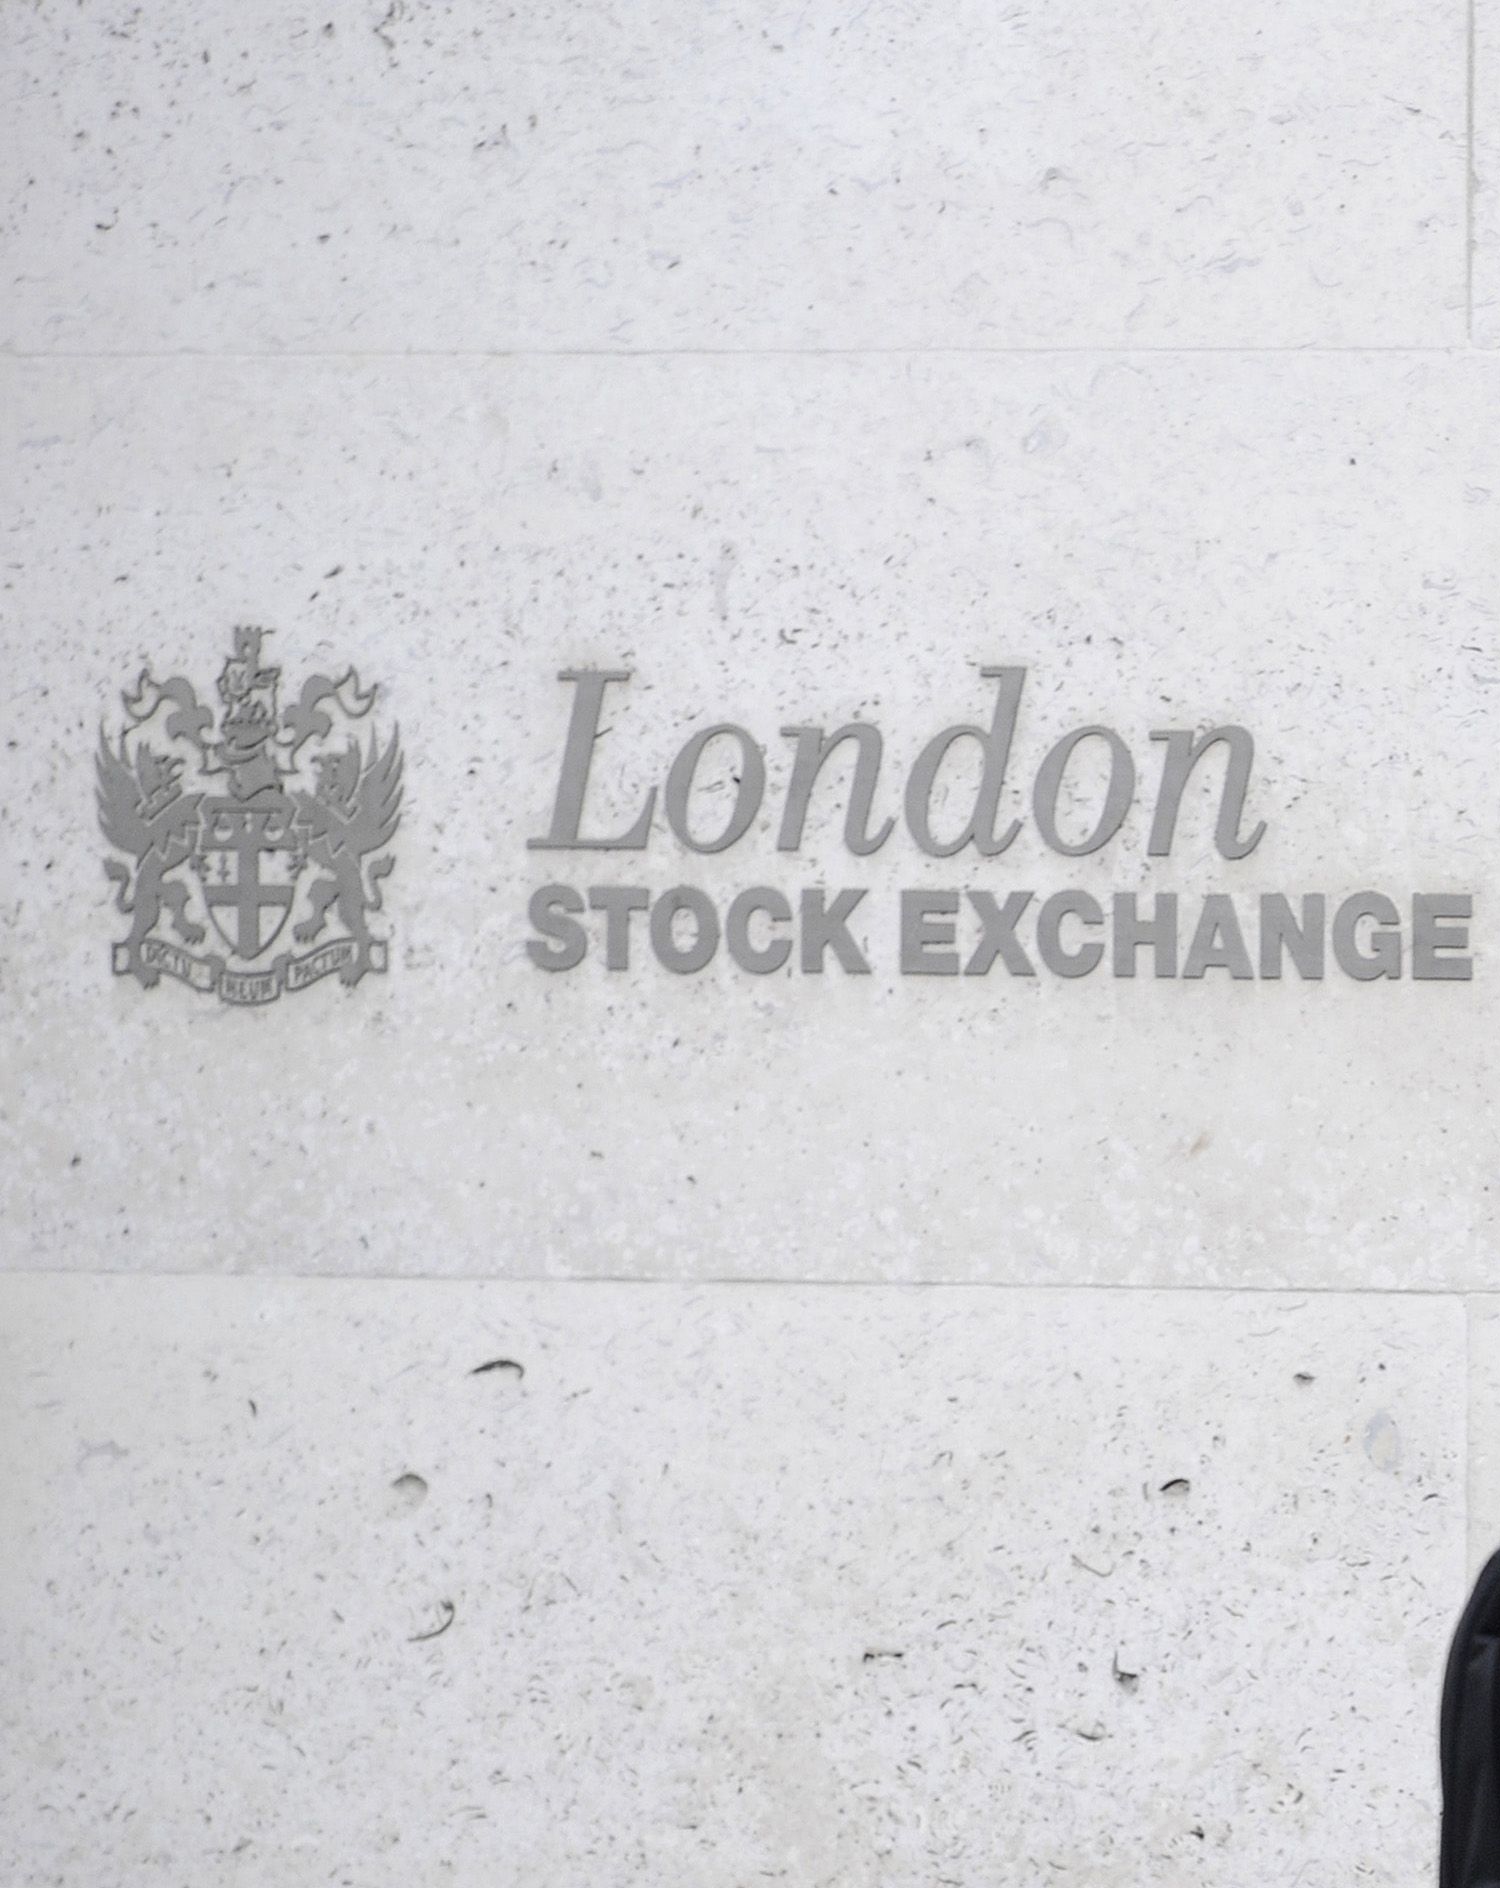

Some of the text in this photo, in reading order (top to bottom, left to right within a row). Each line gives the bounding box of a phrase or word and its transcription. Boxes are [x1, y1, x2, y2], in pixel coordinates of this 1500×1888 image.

[526, 665, 1268, 861] London
[525, 882, 1474, 983] STOCK EXCHANGE
